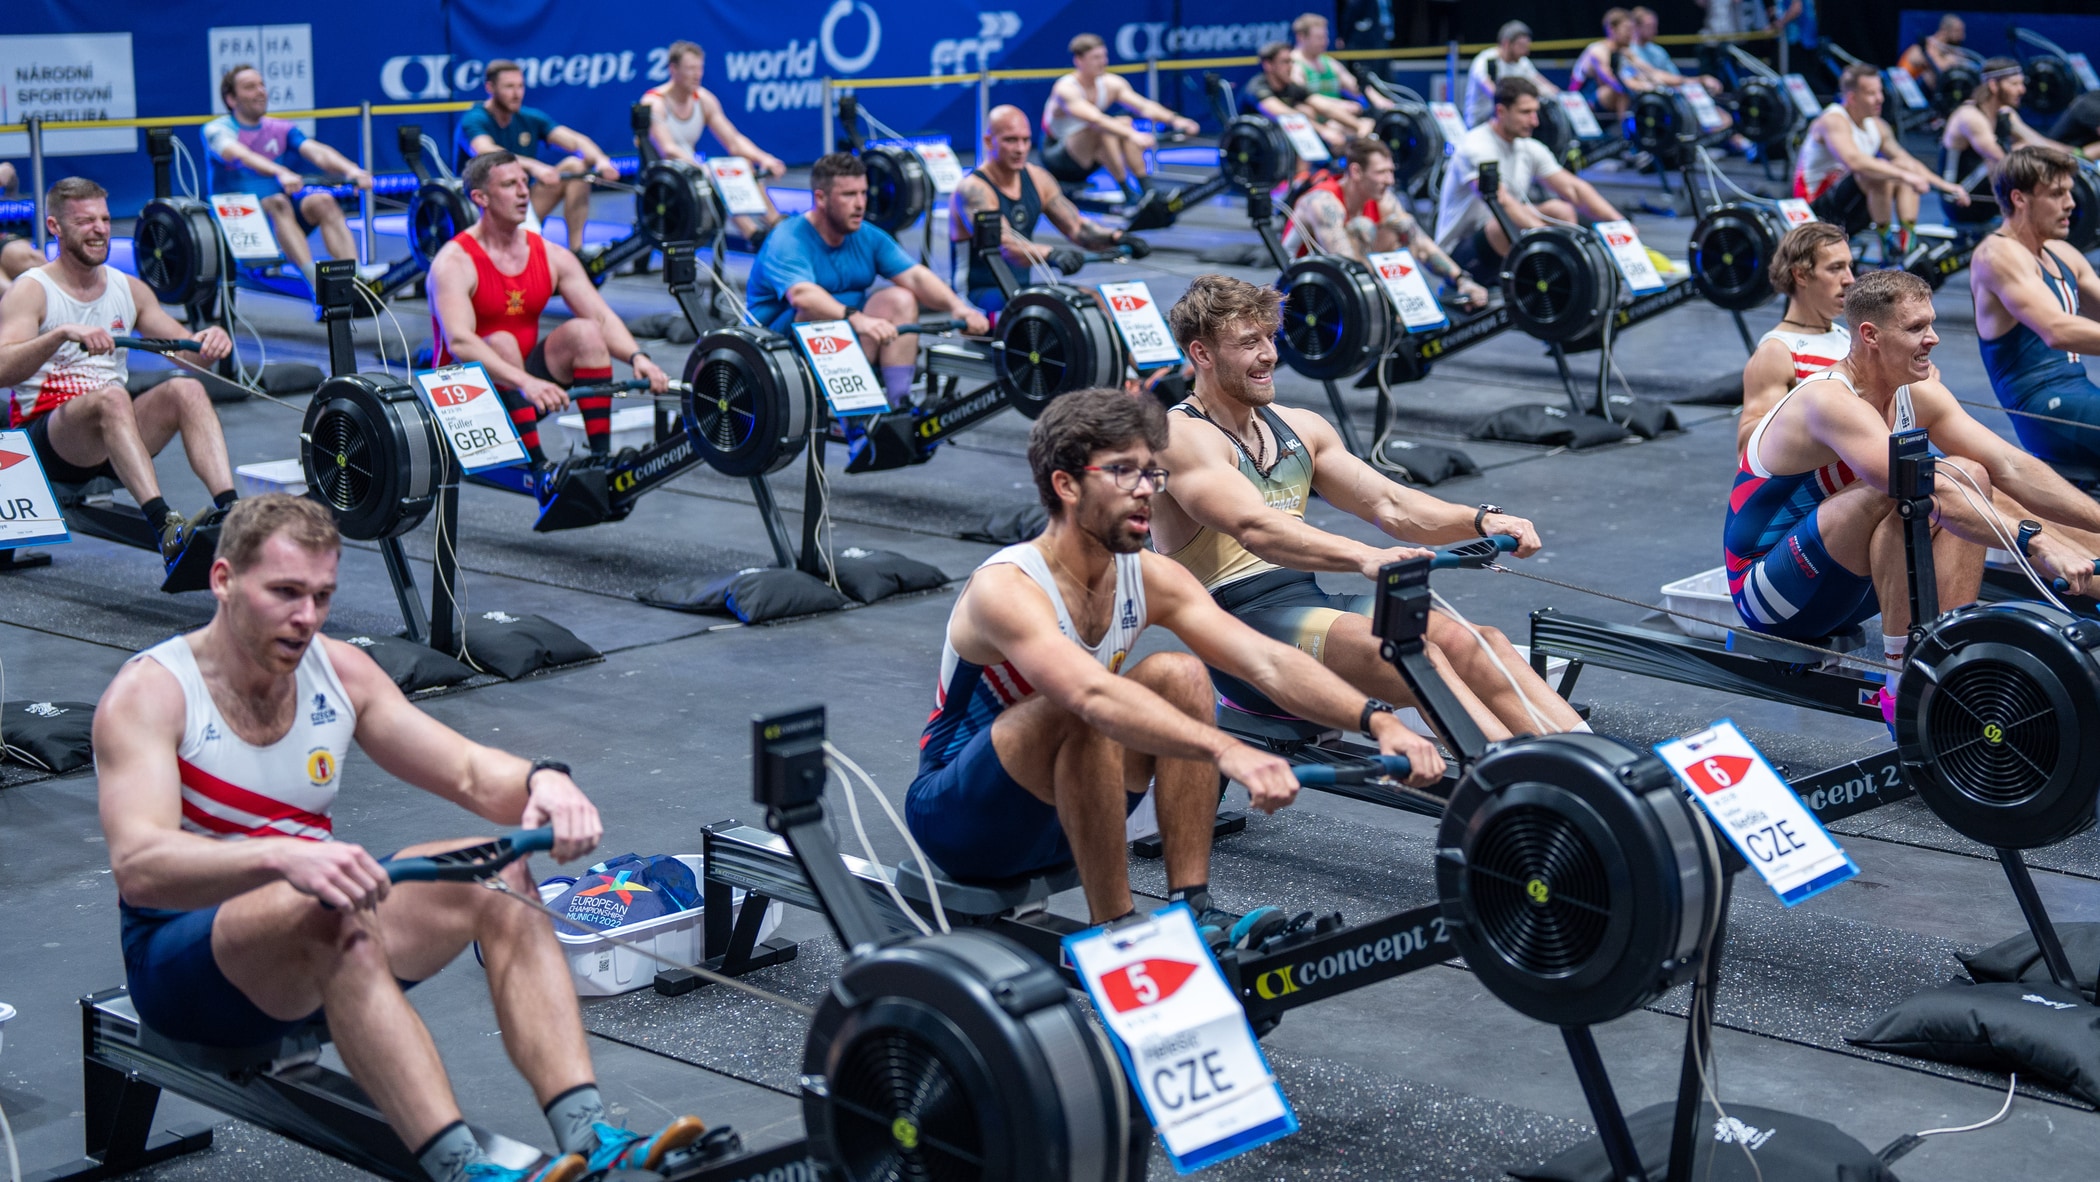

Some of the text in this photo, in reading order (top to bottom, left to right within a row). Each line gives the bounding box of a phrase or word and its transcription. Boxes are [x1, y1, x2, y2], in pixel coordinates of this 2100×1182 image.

[454, 48, 671, 92] cncept 2
[725, 38, 818, 82] world
[15, 63, 94, 84] NÁRODNÍ
[16, 84, 113, 106] SPORTOVNÍ
[745, 80, 854, 114] rowin
[1115, 295, 1137, 311] 21
[814, 336, 838, 354] 20
[1130, 331, 1163, 348] ARG
[441, 384, 468, 404] 19
[828, 374, 868, 395] GBR
[448, 419, 474, 431] Fuller
[454, 427, 502, 451] GBR
[633, 439, 694, 481] concept
[1703, 758, 1732, 787] 6
[1801, 765, 1901, 811] cept 2
[1746, 819, 1806, 863] CZE
[568, 905, 625, 921] CHAMPIONSHIPS
[571, 895, 629, 915] EUROPEAN
[566, 912, 623, 929] MUNICH 2022
[1299, 916, 1451, 985] concept 2
[1126, 962, 1161, 1006] 5
[1152, 1050, 1234, 1112] CZE
